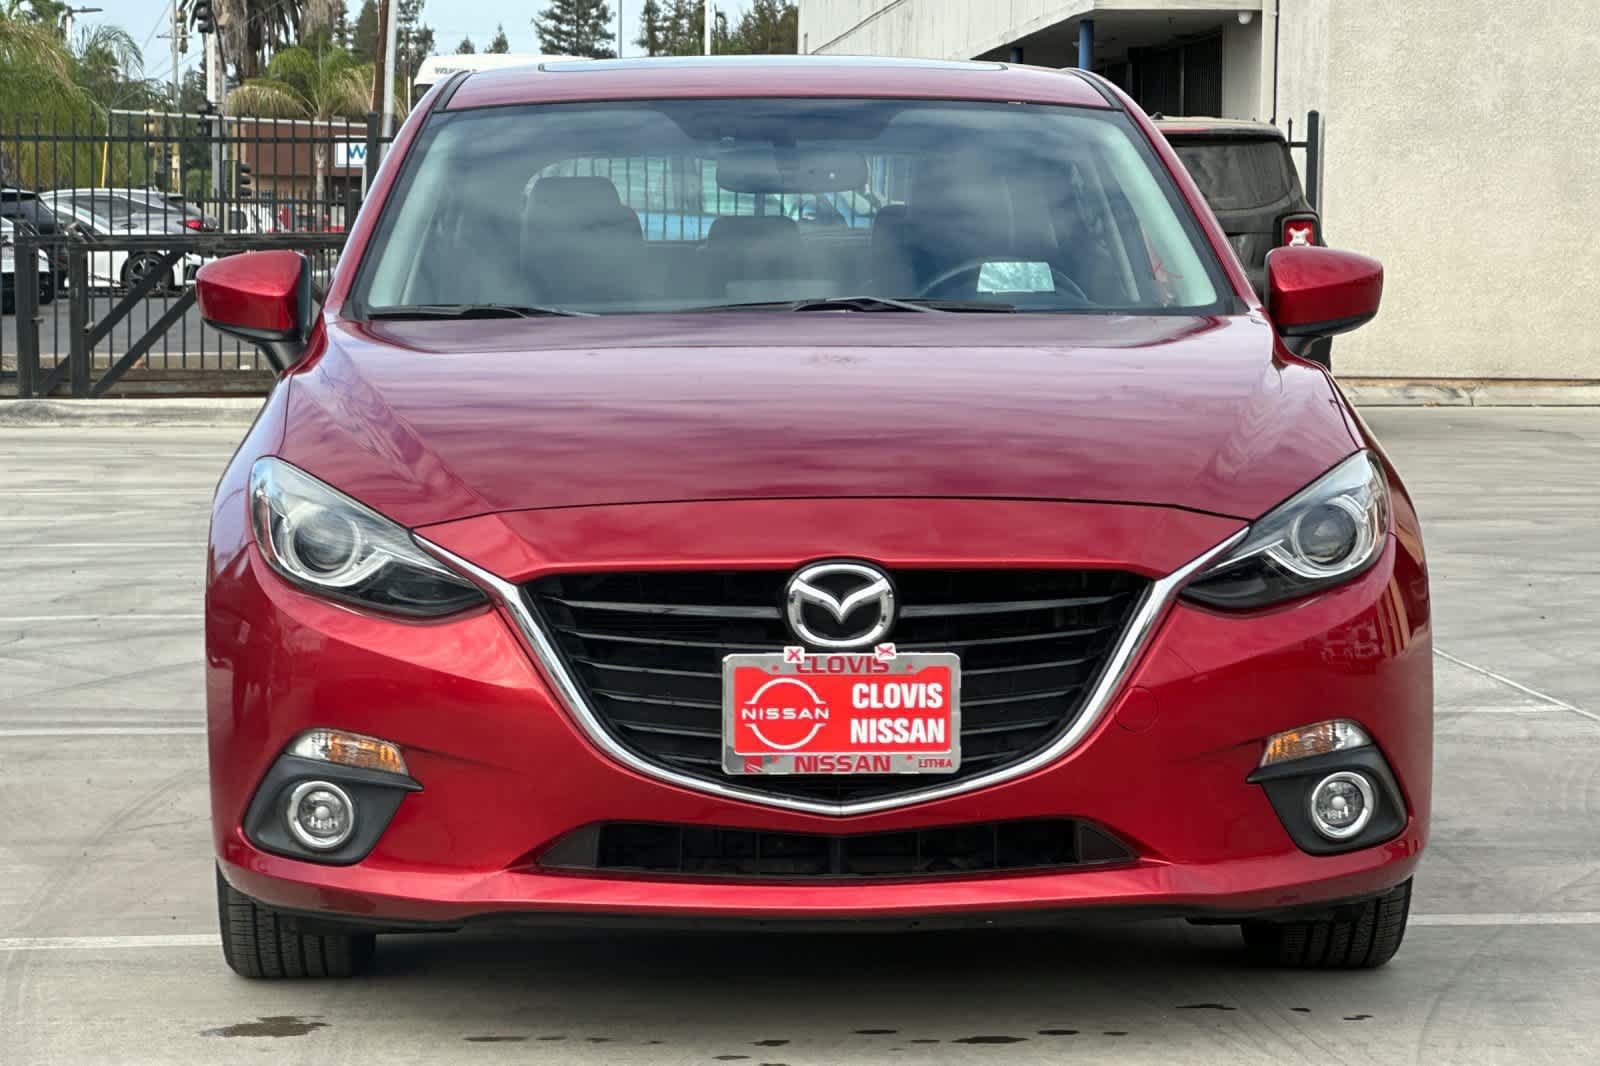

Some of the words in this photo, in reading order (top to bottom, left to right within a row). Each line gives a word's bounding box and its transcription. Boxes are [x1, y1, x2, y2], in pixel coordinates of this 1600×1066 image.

[852, 682, 944, 709] CLOVIS
[741, 707, 830, 720] NISSAN
[850, 717, 945, 744] NISSAN
[794, 755, 891, 773] NISSAN
[918, 757, 953, 769] LITHIA
